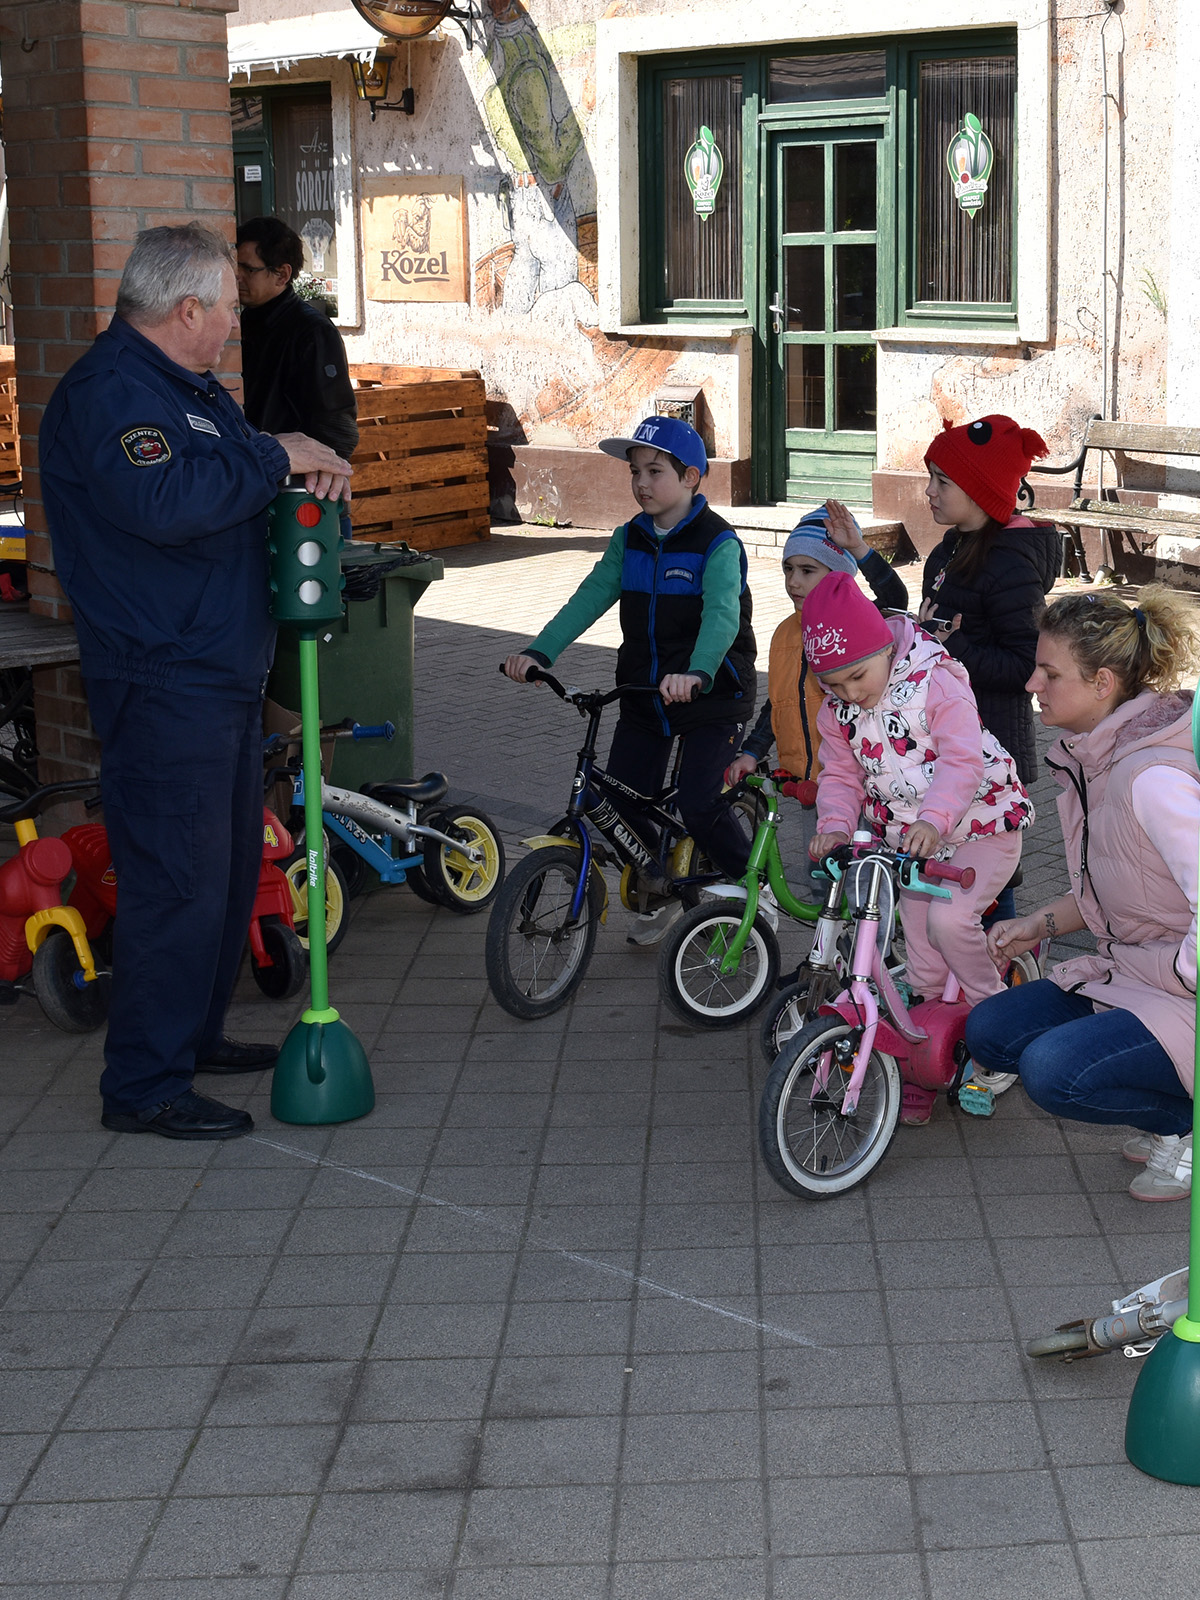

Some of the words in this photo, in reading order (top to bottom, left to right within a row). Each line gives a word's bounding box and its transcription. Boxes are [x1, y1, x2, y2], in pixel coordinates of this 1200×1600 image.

[394, 3, 418, 13] 1874
[300, 126, 328, 153] Ász
[694, 190, 714, 199] Kozel
[380, 250, 450, 284] Kozel
[124, 430, 158, 444] SZENTES
[264, 825, 279, 847] 4
[613, 823, 652, 867] GALAXY
[309, 849, 319, 888] Italtrike
